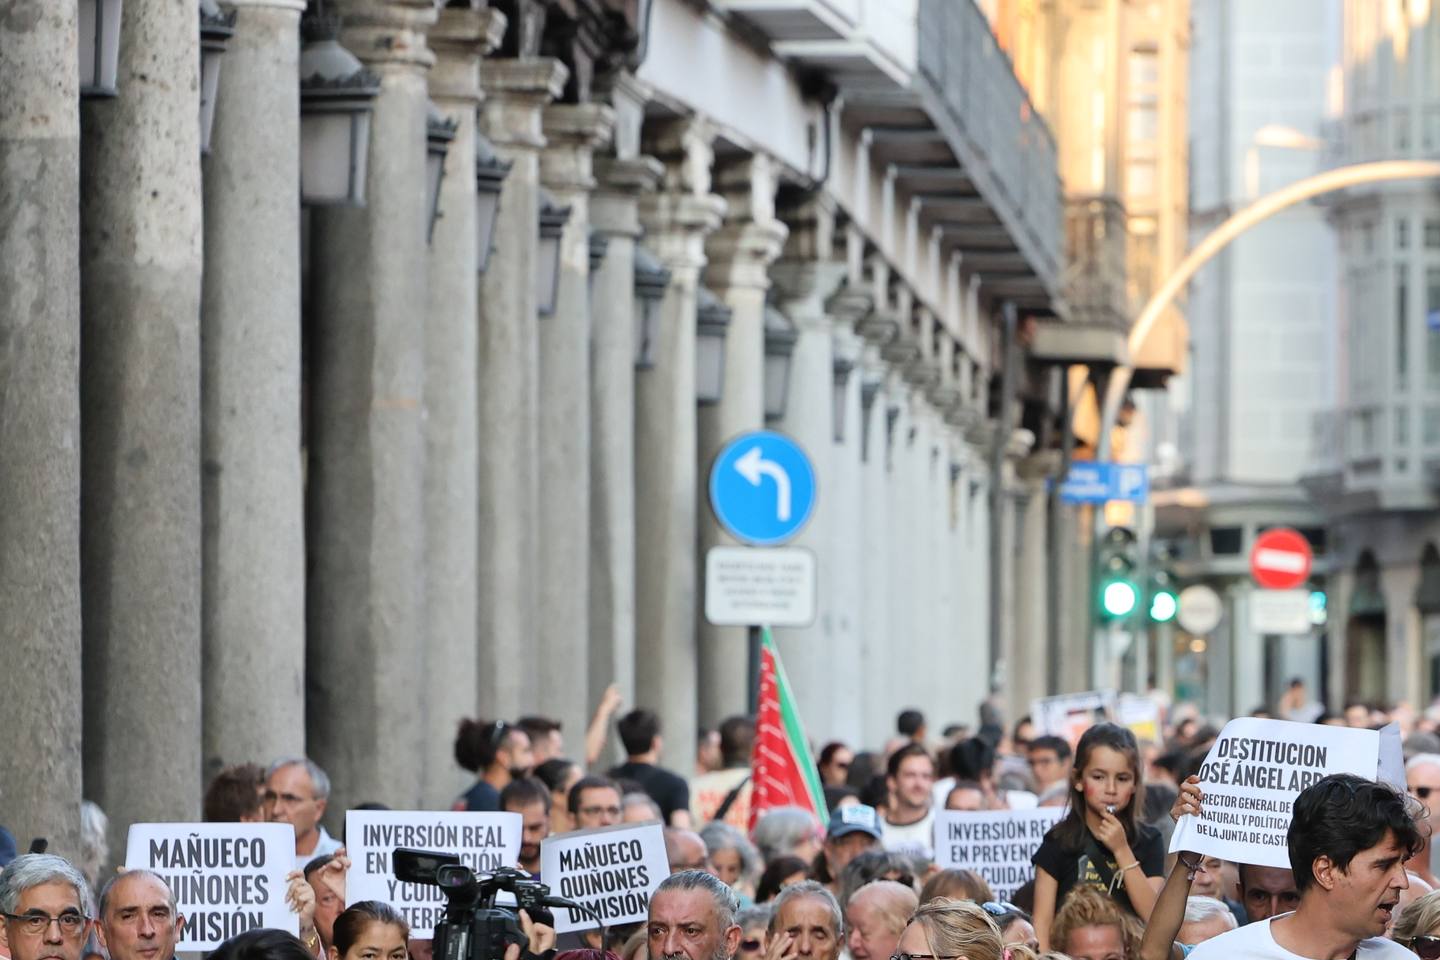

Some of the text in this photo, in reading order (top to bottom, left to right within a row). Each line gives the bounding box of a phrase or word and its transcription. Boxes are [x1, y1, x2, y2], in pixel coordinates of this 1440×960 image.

[1218, 738, 1327, 768] DESTITUCION
[1200, 759, 1231, 785] OSÉ
[1231, 761, 1286, 791] ÁNGEL
[1202, 793, 1291, 814] RECTOR GENERAL DE
[949, 819, 1027, 841] INVERSIÓN
[1197, 823, 1207, 834] DE
[1208, 825, 1219, 838] LA
[1219, 829, 1248, 843] JUNTA
[1249, 832, 1261, 844] DE
[1201, 810, 1241, 826] NATURAL
[1248, 815, 1289, 830] POLÍTICA
[363, 821, 506, 848] INVERSIÓN REAL
[149, 832, 266, 869] MAÑUECO
[366, 852, 387, 875] EN
[560, 839, 643, 872] MAÑUECO
[951, 843, 1040, 862] EN PREVENC
[164, 870, 269, 906] UIÑONES
[561, 865, 649, 899] QUIÑONES
[981, 866, 1036, 885] CUIDAD
[387, 880, 399, 901] Y
[568, 890, 649, 924] DIMISIÓN
[180, 906, 264, 942] MISIÓN
